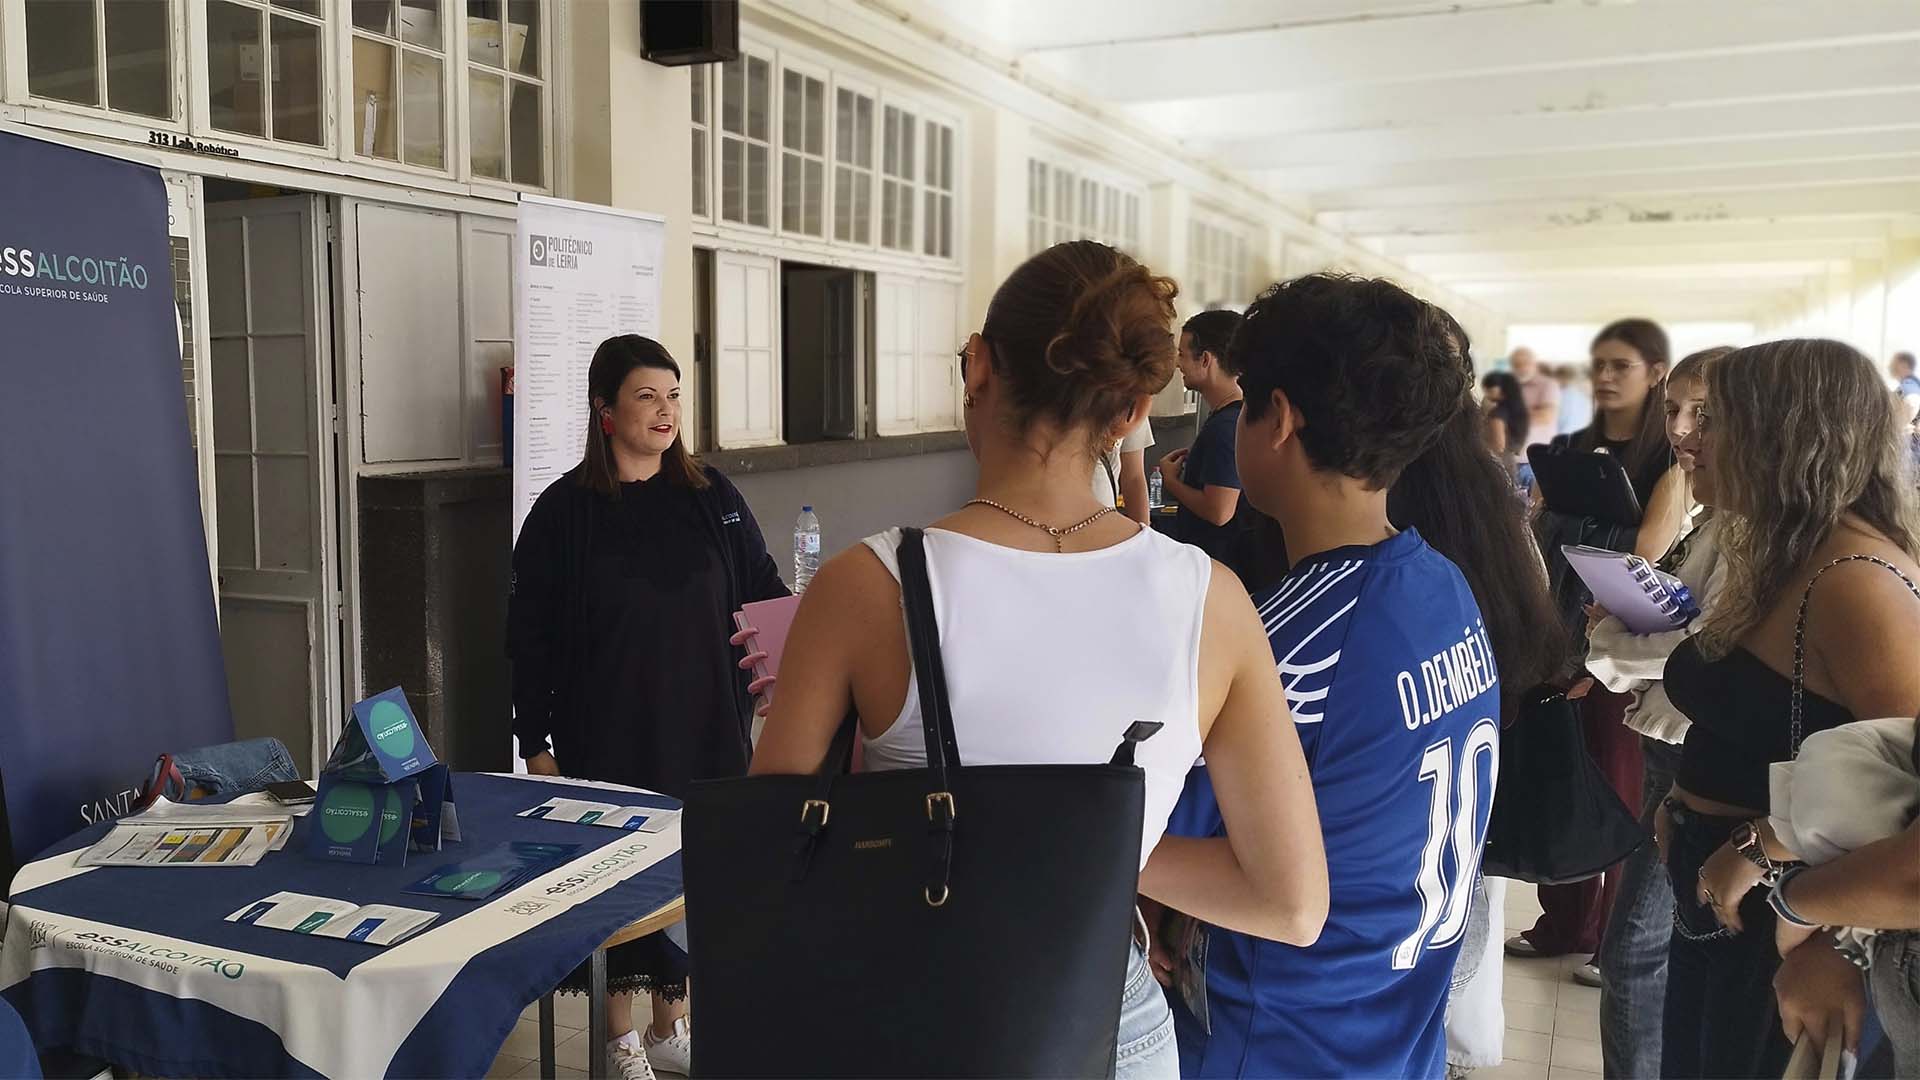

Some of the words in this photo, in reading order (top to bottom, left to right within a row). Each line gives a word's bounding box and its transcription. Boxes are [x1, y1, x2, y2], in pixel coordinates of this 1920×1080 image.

[149, 131, 169, 146] 313
[197, 142, 239, 157] Robótica
[548, 235, 593, 256] POLITÉCNICO
[556, 253, 579, 270] LEIRIA
[0, 247, 148, 290] ssALCOITÃO
[24, 286, 67, 299] SUPERIOR
[69, 291, 81, 301] DE
[82, 291, 109, 304] SAÚDE
[1392, 718, 1499, 970] 10
[545, 844, 648, 895] essALCOITÃO
[66, 941, 93, 951] ESCOLA
[94, 945, 134, 960] SUPERIOR
[135, 955, 147, 966] DE
[149, 959, 180, 975] SAÚDE
[74, 932, 245, 980] essALCOITÃO
